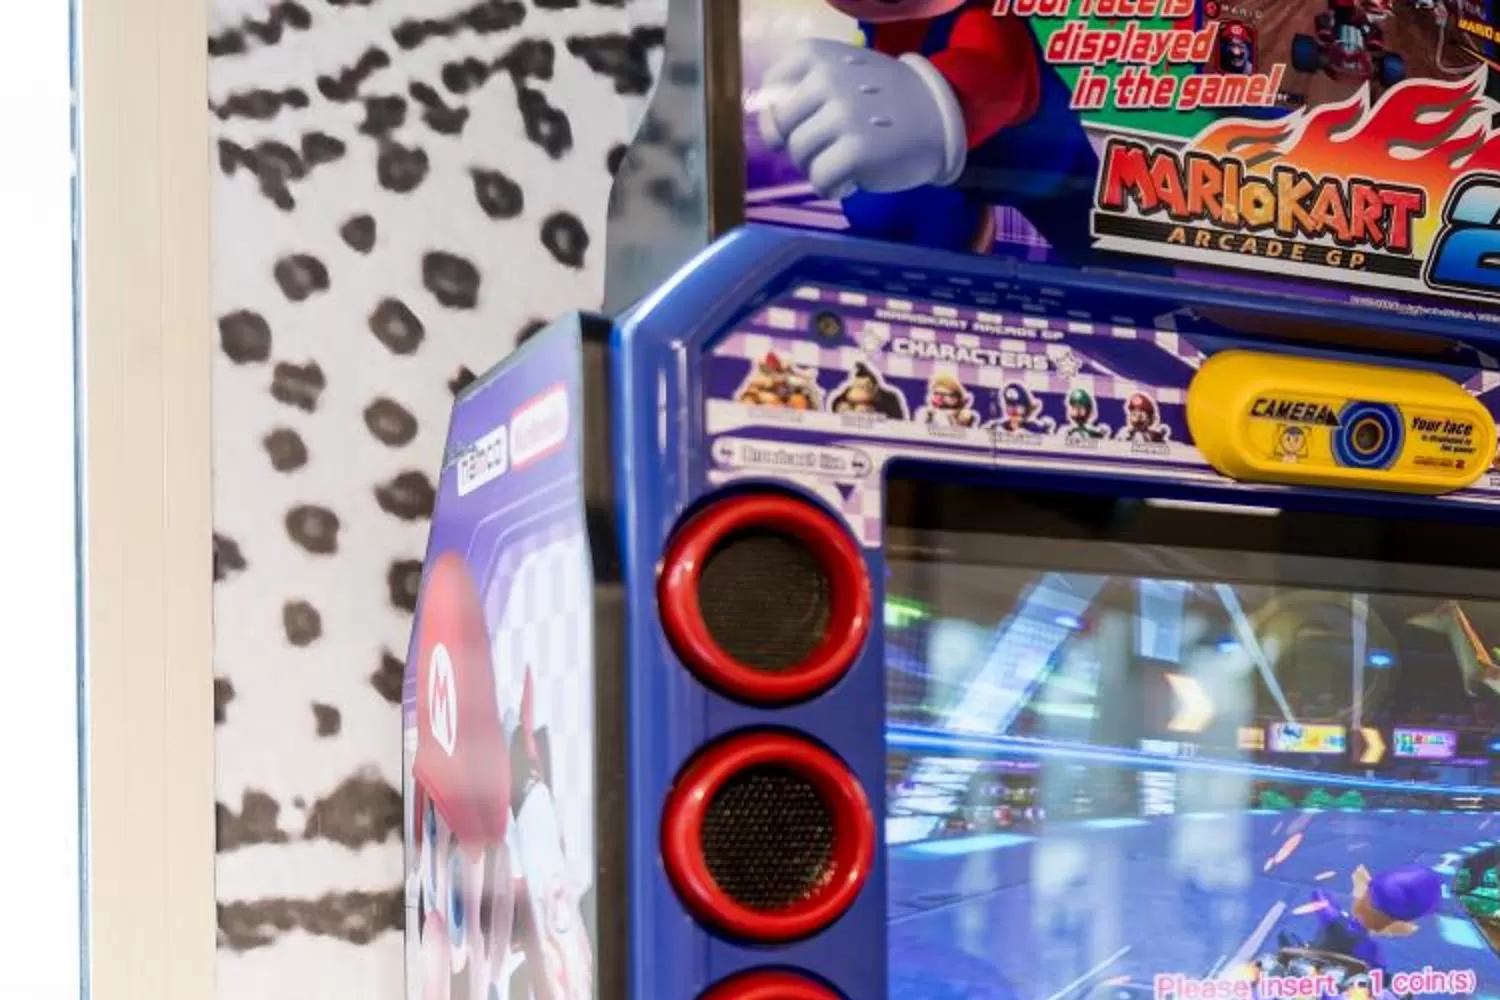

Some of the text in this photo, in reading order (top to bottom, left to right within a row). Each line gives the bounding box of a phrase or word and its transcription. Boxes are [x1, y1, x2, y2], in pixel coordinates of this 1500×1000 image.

[1045, 21, 1219, 64] displayed
[1069, 63, 1287, 110] in the game!
[1168, 227, 1367, 270] ARCADE GP
[892, 337, 1049, 371] CHARACTERS
[1249, 398, 1331, 424] CAMERA
[1411, 416, 1473, 436] Your face
[1260, 971, 1337, 998] insert
[1370, 969, 1385, 997] 1
[1393, 965, 1476, 997] coin(s)
